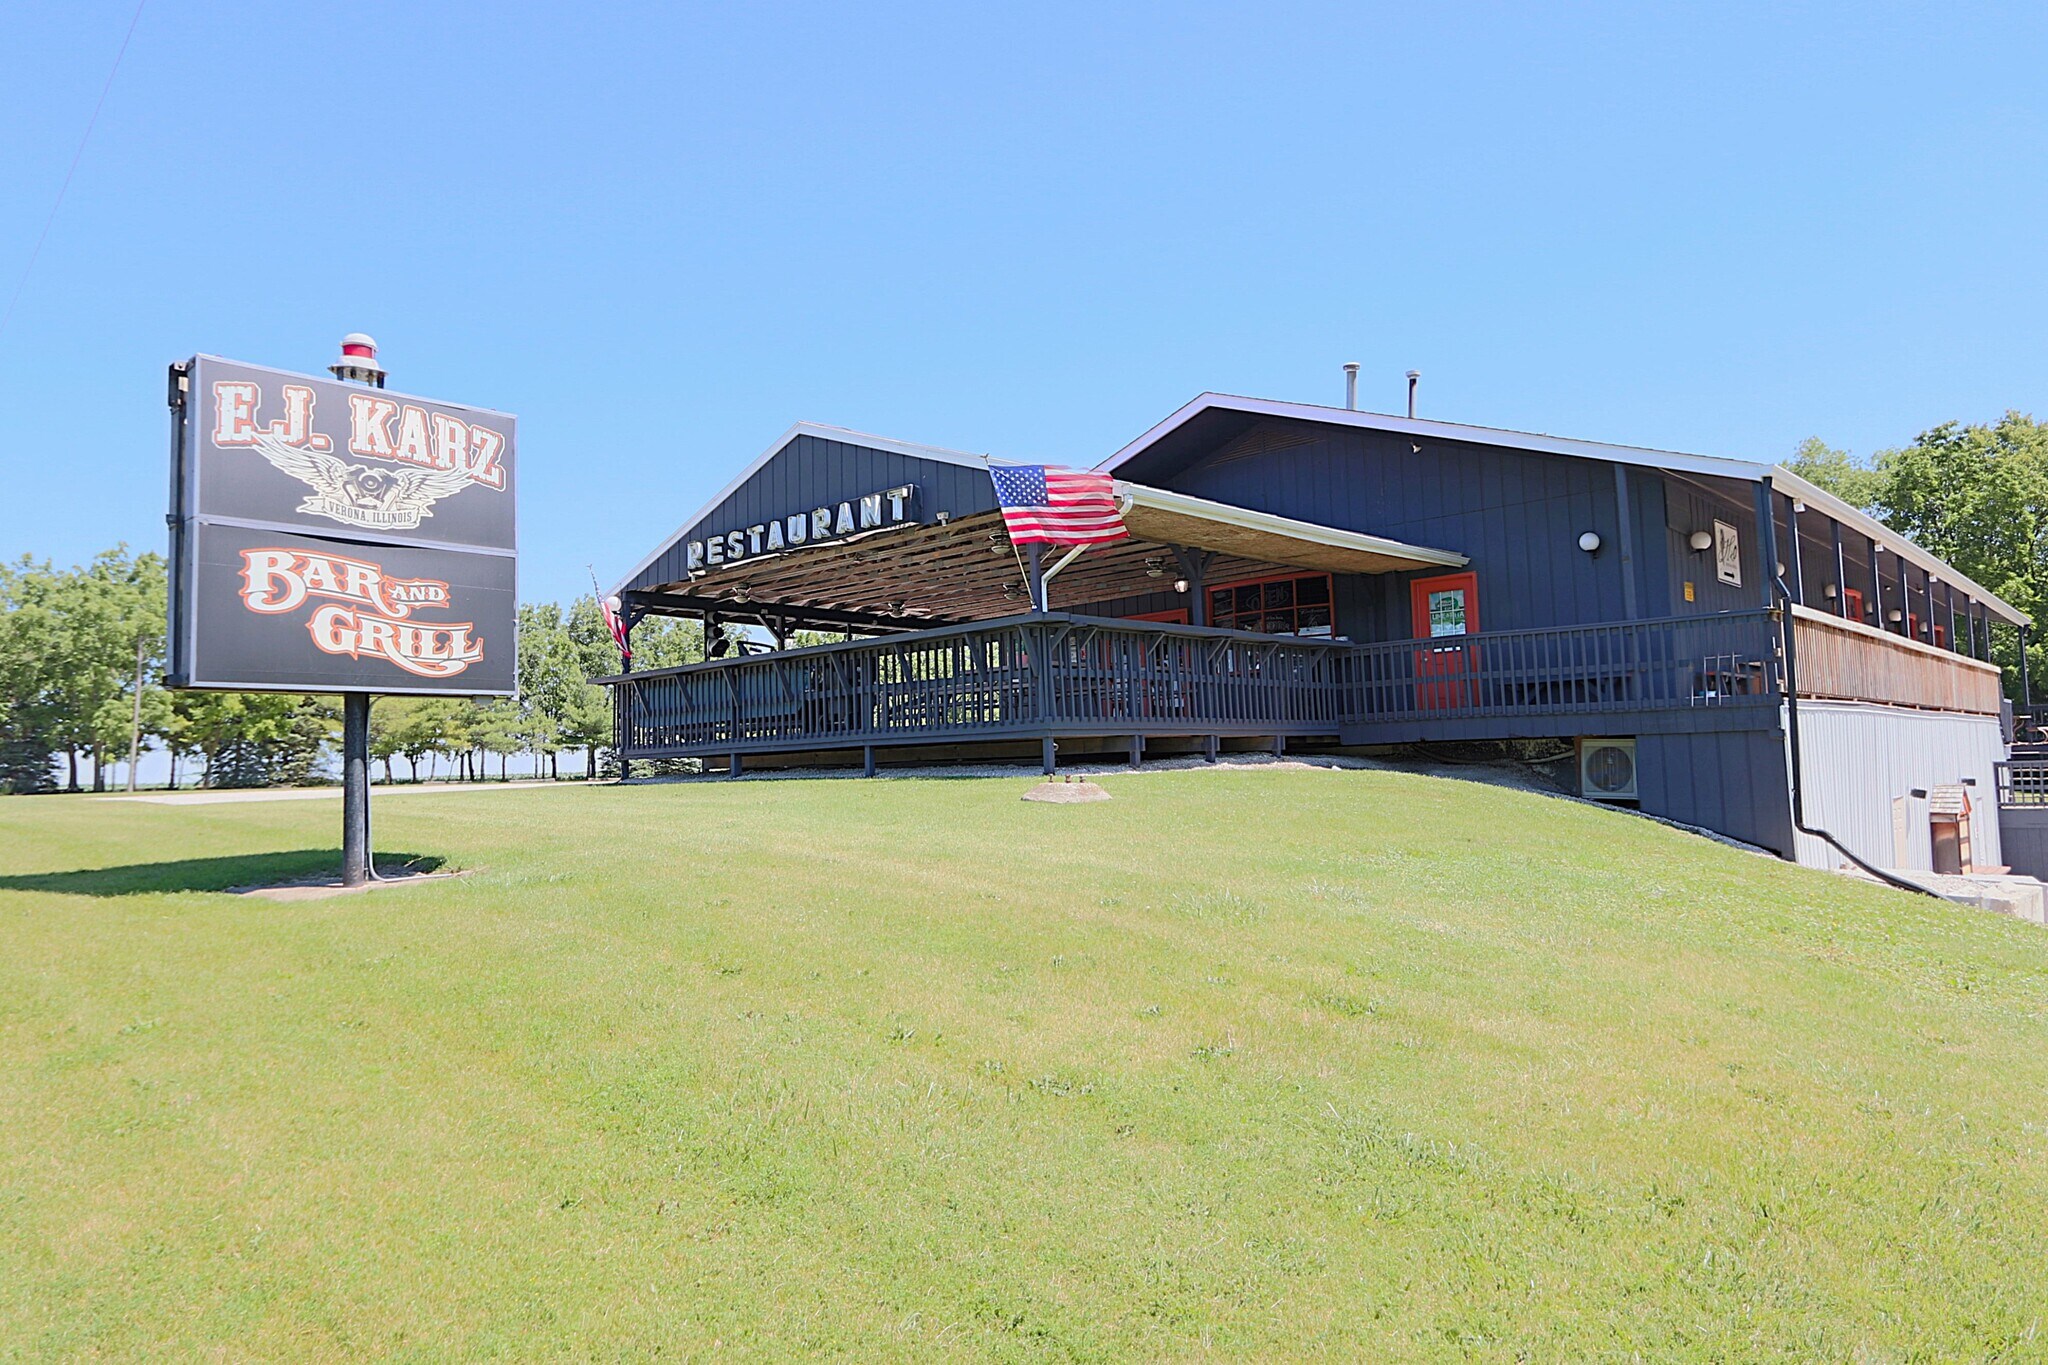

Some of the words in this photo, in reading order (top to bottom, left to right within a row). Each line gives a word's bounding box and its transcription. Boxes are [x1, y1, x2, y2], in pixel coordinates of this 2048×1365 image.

[349, 394, 505, 491] KARZ
[372, 511, 412, 524] ILLINOIS
[687, 487, 908, 569] RESTAURANT
[388, 582, 448, 604] AND
[307, 605, 483, 677] GRILL
